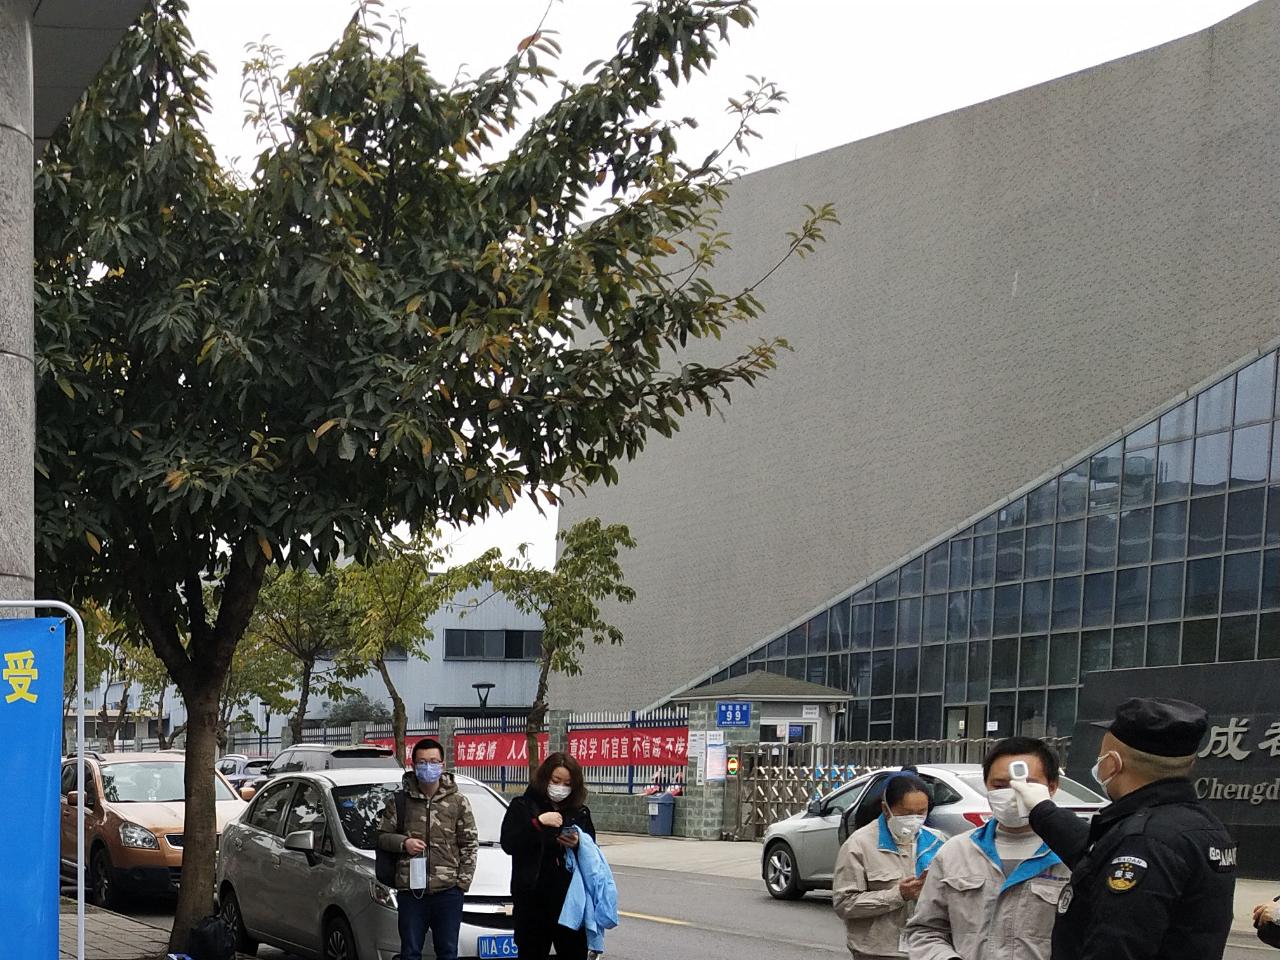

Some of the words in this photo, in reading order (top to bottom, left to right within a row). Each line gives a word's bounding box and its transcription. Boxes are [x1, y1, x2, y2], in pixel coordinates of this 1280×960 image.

[457, 740, 498, 761] 抗击疫情
[570, 737, 598, 759] 重科学
[601, 736, 629, 759] 听官宣
[632, 736, 661, 758] 不信谣
[665, 736, 689, 759] 不传
